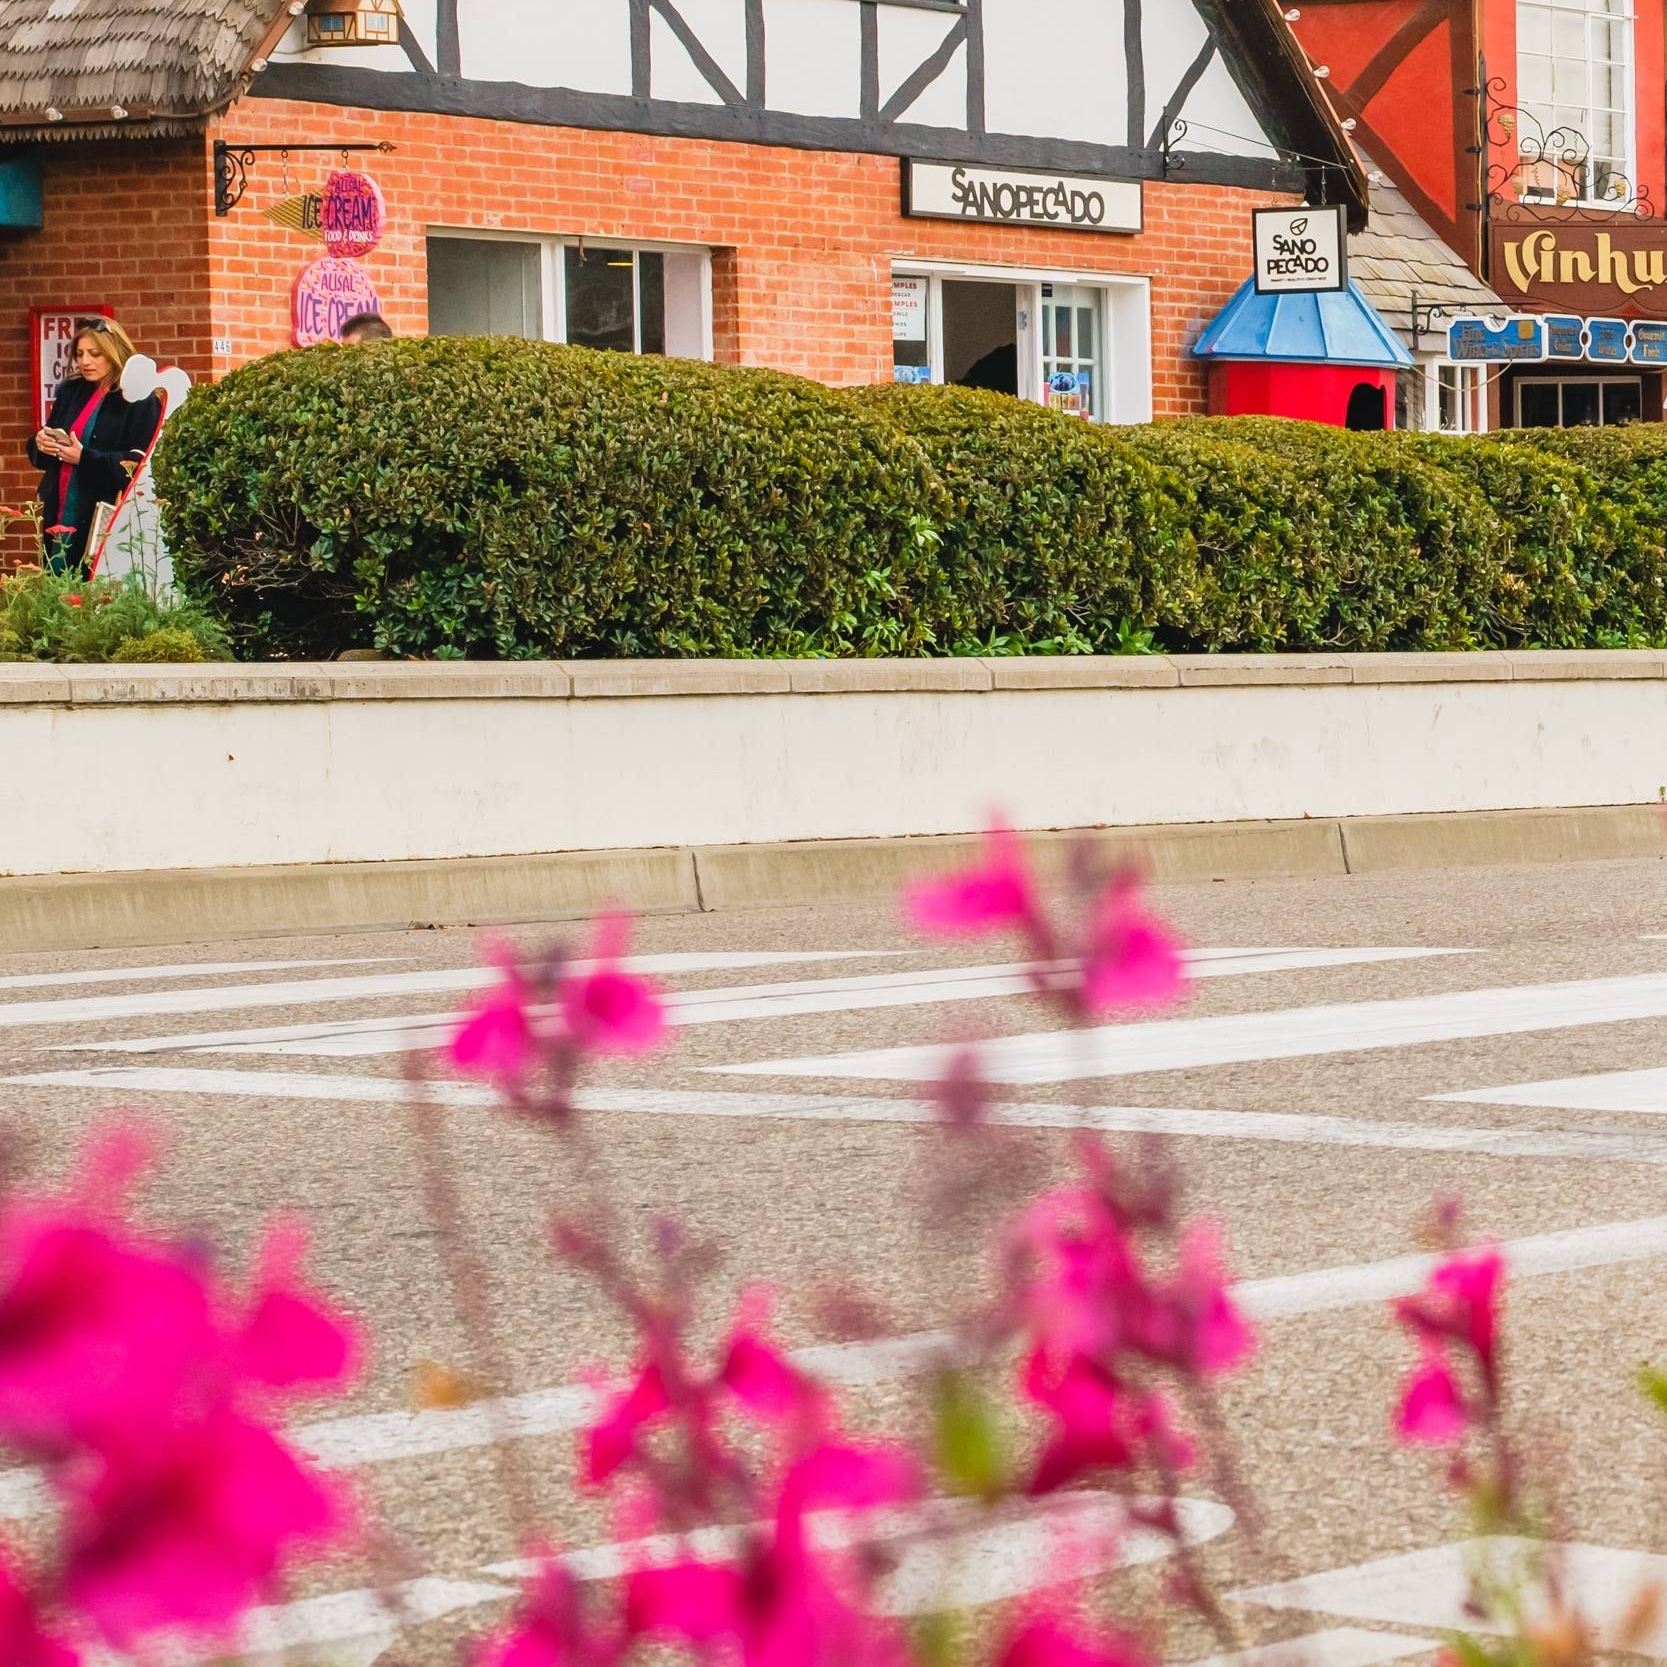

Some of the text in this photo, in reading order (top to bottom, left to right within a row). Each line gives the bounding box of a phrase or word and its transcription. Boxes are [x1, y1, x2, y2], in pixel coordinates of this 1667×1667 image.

[335, 179, 363, 193] ALISAL
[951, 166, 1105, 224] SANOPECADO
[303, 195, 373, 230] ICE CREAM
[325, 232, 341, 241] FOOD
[349, 232, 373, 242] DRINKS
[1272, 234, 1316, 255] SANO
[1267, 255, 1329, 275] PECADO
[321, 273, 356, 292] ALISAL
[300, 292, 322, 333] ICE
[214, 340, 231, 352] 446
